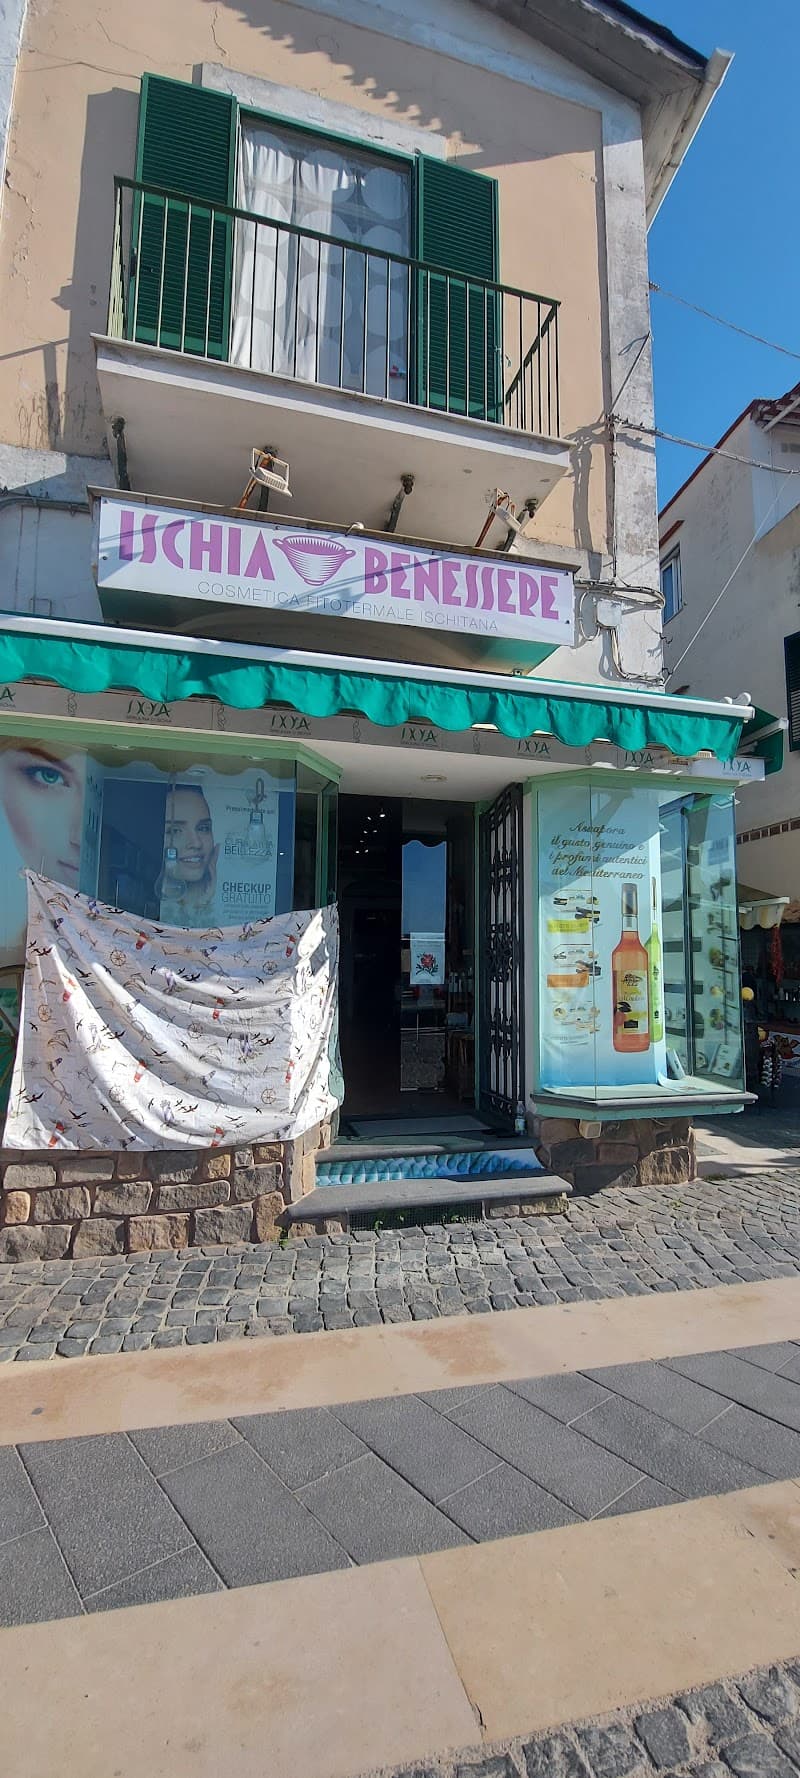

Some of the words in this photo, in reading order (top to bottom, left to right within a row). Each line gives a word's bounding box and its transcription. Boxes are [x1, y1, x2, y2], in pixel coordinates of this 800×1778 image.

[119, 509, 275, 581] ISCHIA
[363, 547, 560, 620] BENESSERE
[197, 580, 300, 606] COSMETICA
[307, 594, 414, 620] FITOTERMALE
[420, 609, 498, 632] ISCHITANA
[127, 699, 171, 717] IXYA
[271, 714, 311, 730] IXYA
[401, 727, 437, 743] IXYA
[517, 739, 551, 754] IXYA
[624, 751, 656, 765] IXYA
[550, 834, 560, 846] il
[559, 837, 590, 849] gusto
[592, 840, 636, 852] genuino
[224, 846, 273, 857] BELLEZZA
[552, 850, 600, 866] profumi
[602, 855, 648, 865] autentici
[551, 864, 569, 876] del
[569, 865, 645, 880] Mediterraneo
[222, 881, 272, 893] CHECKUP
[221, 892, 271, 905] GRATUITO
